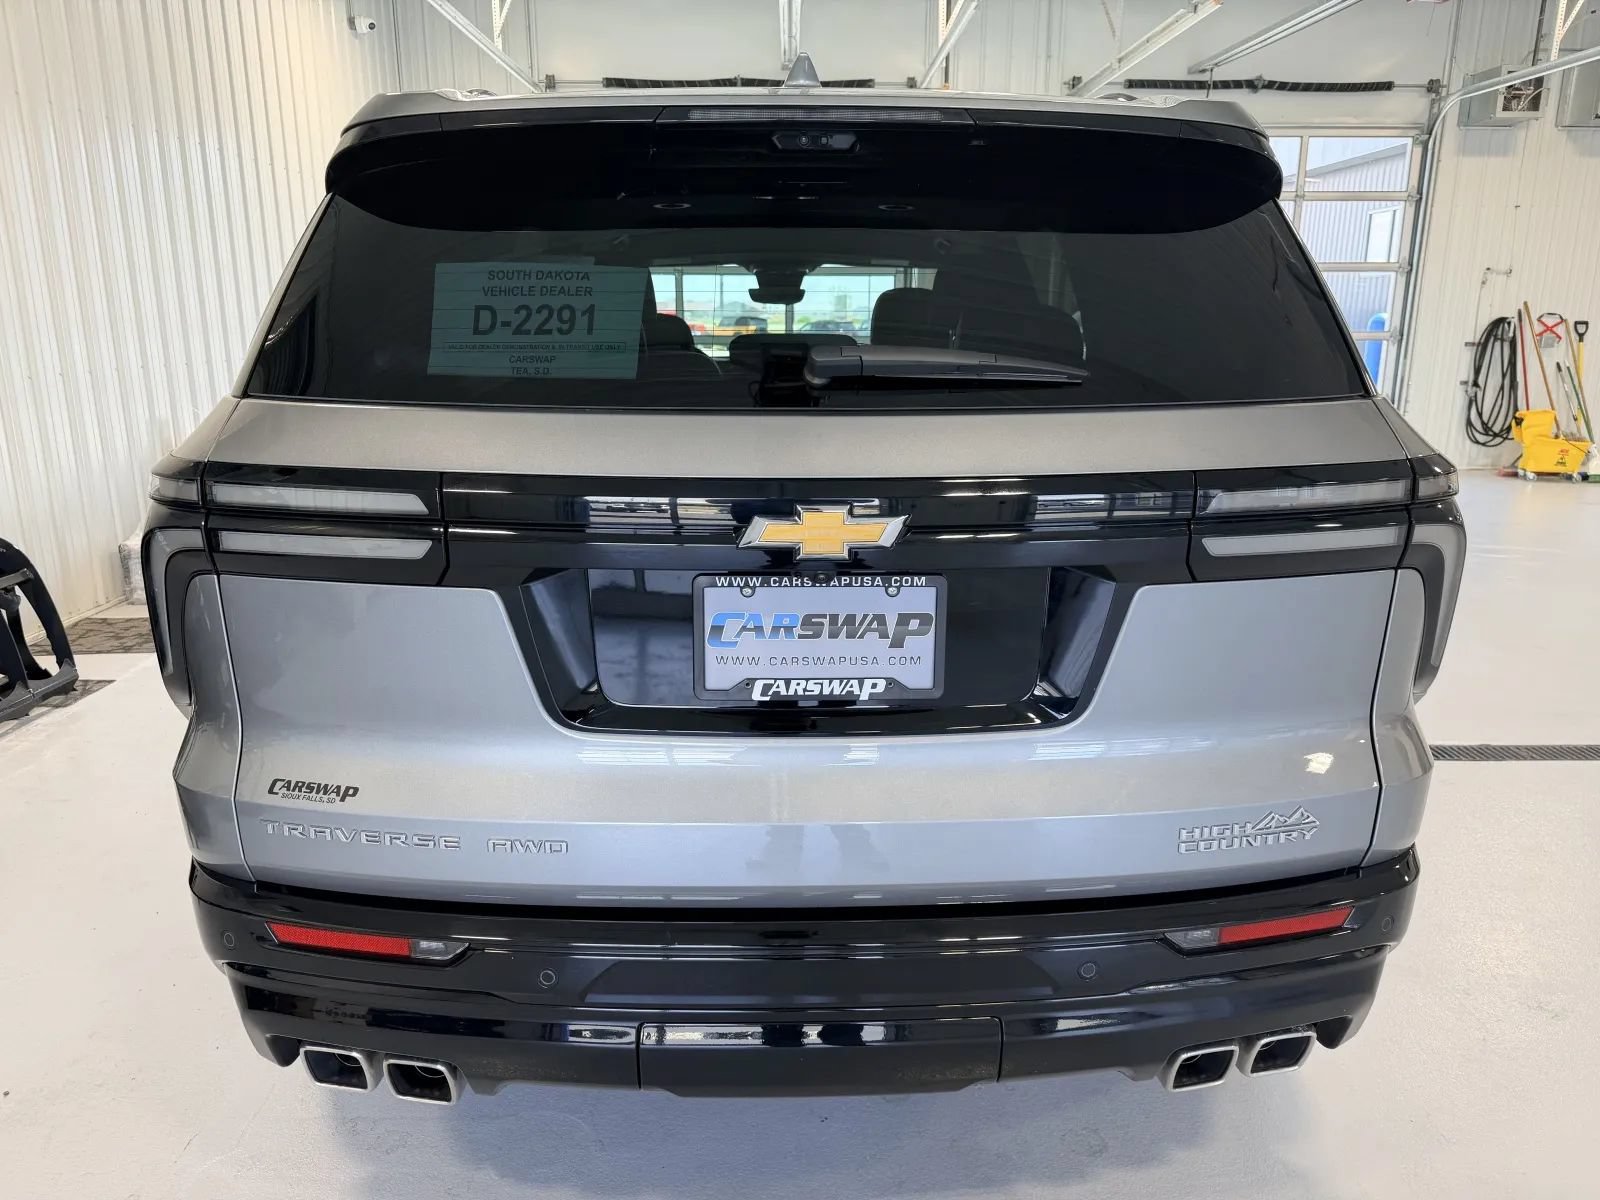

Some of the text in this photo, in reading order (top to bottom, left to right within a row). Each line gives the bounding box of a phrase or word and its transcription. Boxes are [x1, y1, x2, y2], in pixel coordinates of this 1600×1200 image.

[487, 270, 590, 281] SOUTH DAKOTA
[482, 286, 593, 297] VEHICLE DEALER
[472, 303, 596, 336] D-2291
[508, 355, 556, 364] CARSWAP
[533, 367, 553, 376] S.D.
[715, 576, 927, 587] WWW.CARSAPUSA.COM
[706, 612, 935, 649] CARSWAP
[715, 655, 922, 667] WWW.CARSWAPUSA.COM
[751, 678, 887, 701] CARSWAP
[267, 778, 360, 803] CARSWAP
[280, 792, 302, 801] SIOUX
[302, 794, 325, 803] FALLS,
[259, 818, 569, 854] TRAVERSE AWD
[1178, 821, 1252, 841] HIGH
[1178, 827, 1319, 855] COUNTRY
